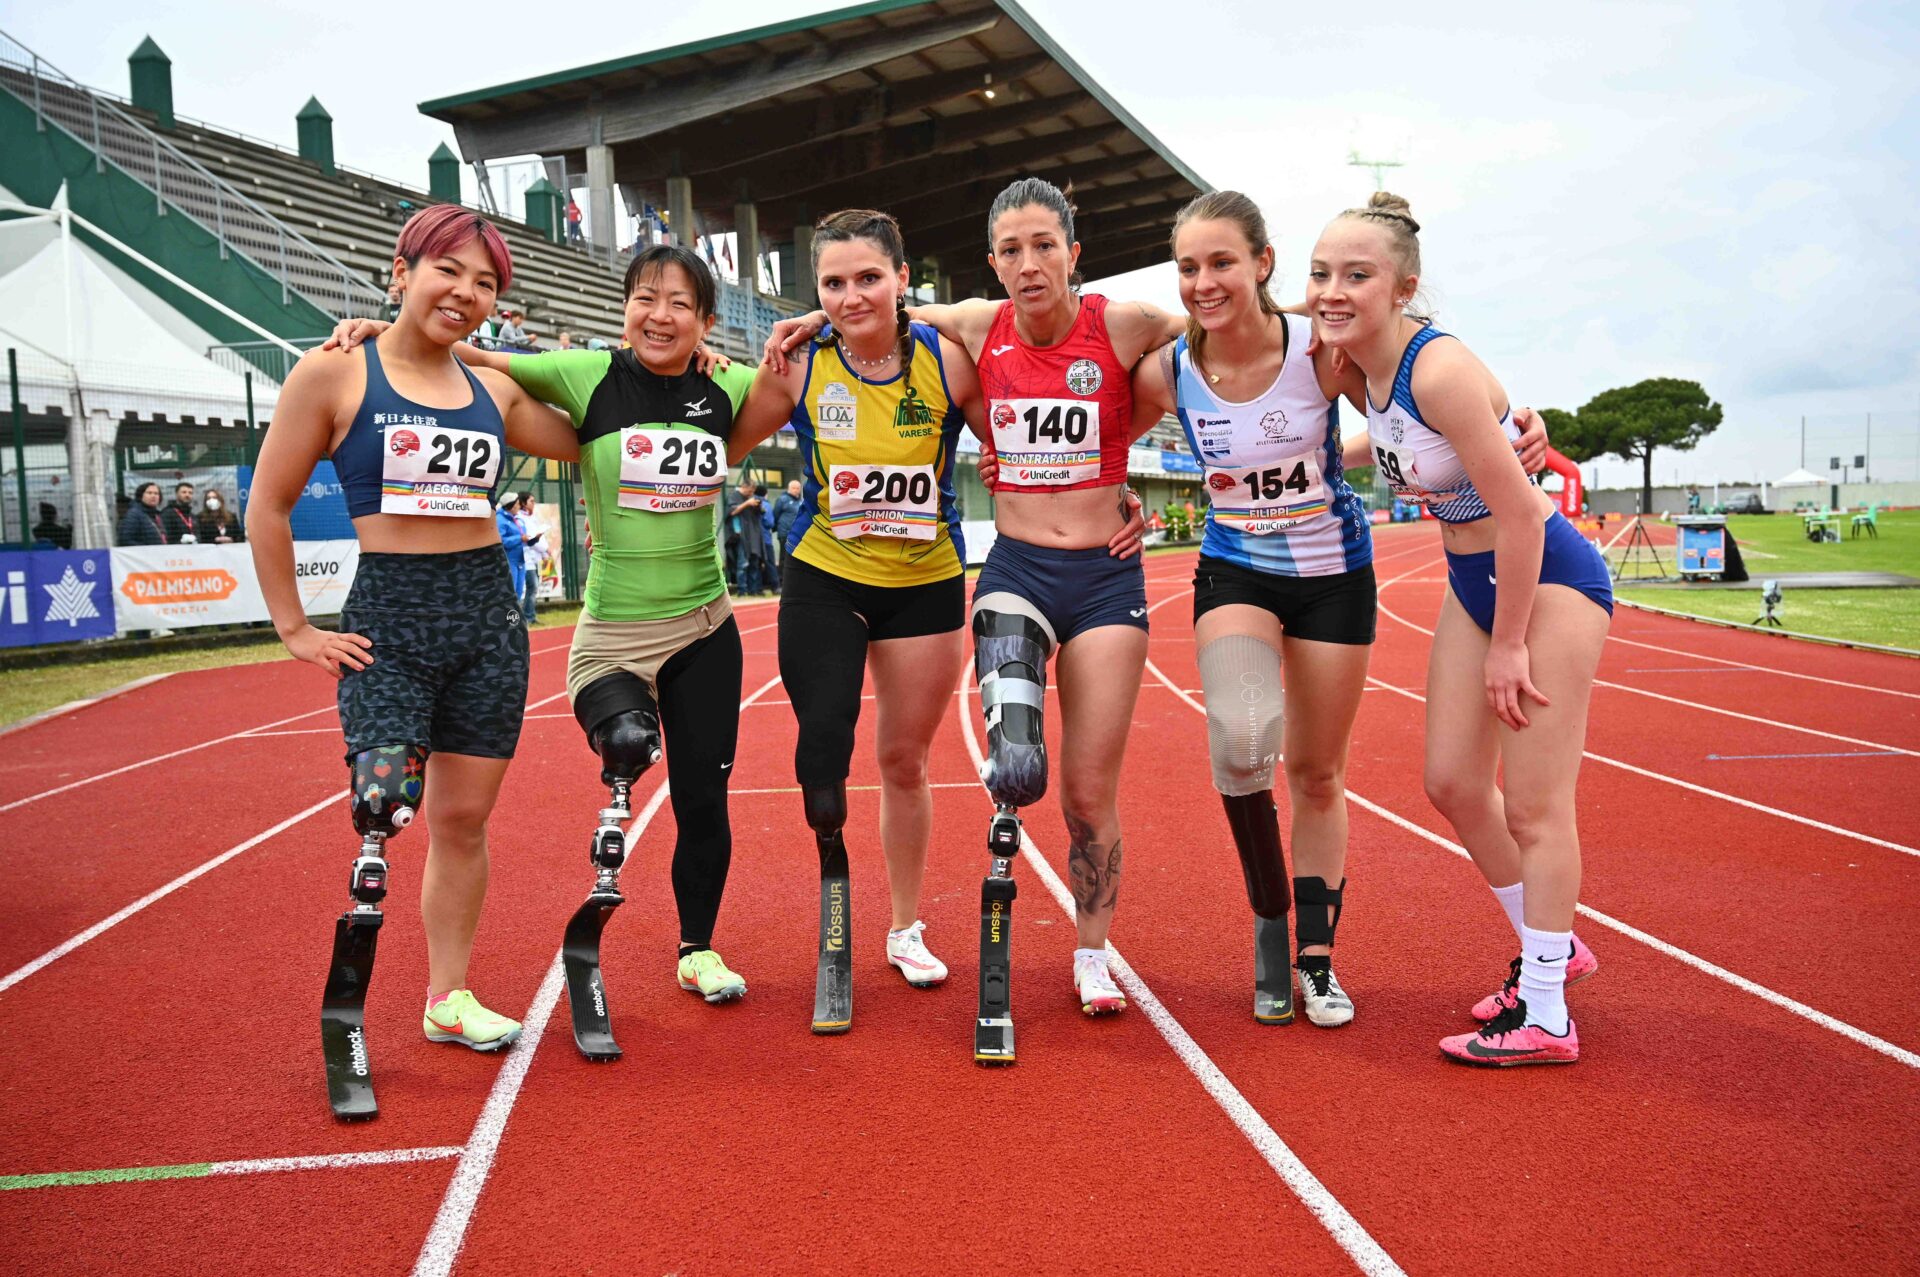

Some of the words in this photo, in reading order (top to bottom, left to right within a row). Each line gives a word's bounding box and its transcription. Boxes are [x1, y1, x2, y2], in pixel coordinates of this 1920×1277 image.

[373, 413, 438, 427] 新日本住設
[1023, 406, 1088, 444] 140
[899, 428, 933, 438] VARESE
[427, 434, 491, 479] 212
[659, 437, 718, 477] 213
[1005, 452, 1087, 464] CONTRAFATTO
[1030, 470, 1070, 480] UniCredit
[1243, 461, 1310, 500] 154
[655, 484, 698, 495] YASUDA
[862, 471, 931, 505] 200
[430, 500, 470, 511] UniCredit
[661, 500, 697, 509] UniCredit
[865, 511, 905, 520] SIMION
[1250, 507, 1289, 518] FILIPPI
[870, 523, 908, 535] UniCredit
[1256, 520, 1297, 531] UniCredit
[135, 576, 223, 598] PALMISANO
[827, 882, 843, 937] ÖSSUR
[990, 902, 1004, 943] ÖSSUR
